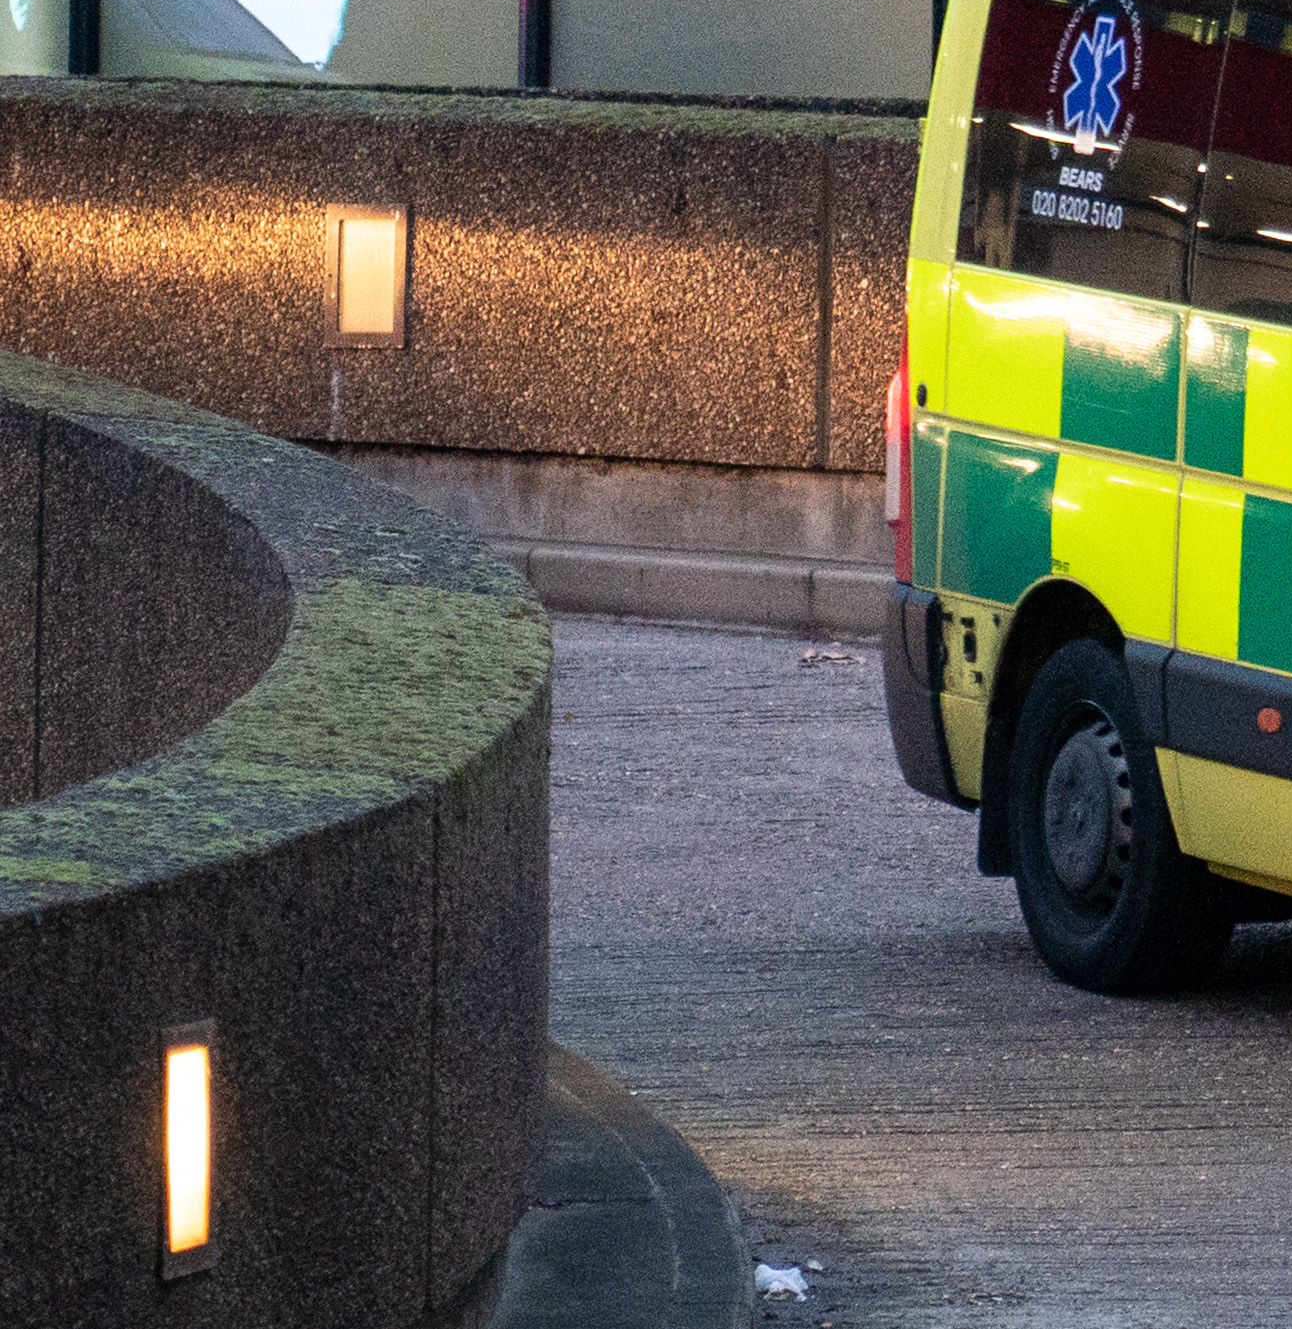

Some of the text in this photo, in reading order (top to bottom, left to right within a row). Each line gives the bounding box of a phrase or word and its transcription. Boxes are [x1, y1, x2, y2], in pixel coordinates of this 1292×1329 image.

[1059, 166, 1103, 192] BEARS
[1032, 190, 1123, 230] 020 8202 5160
